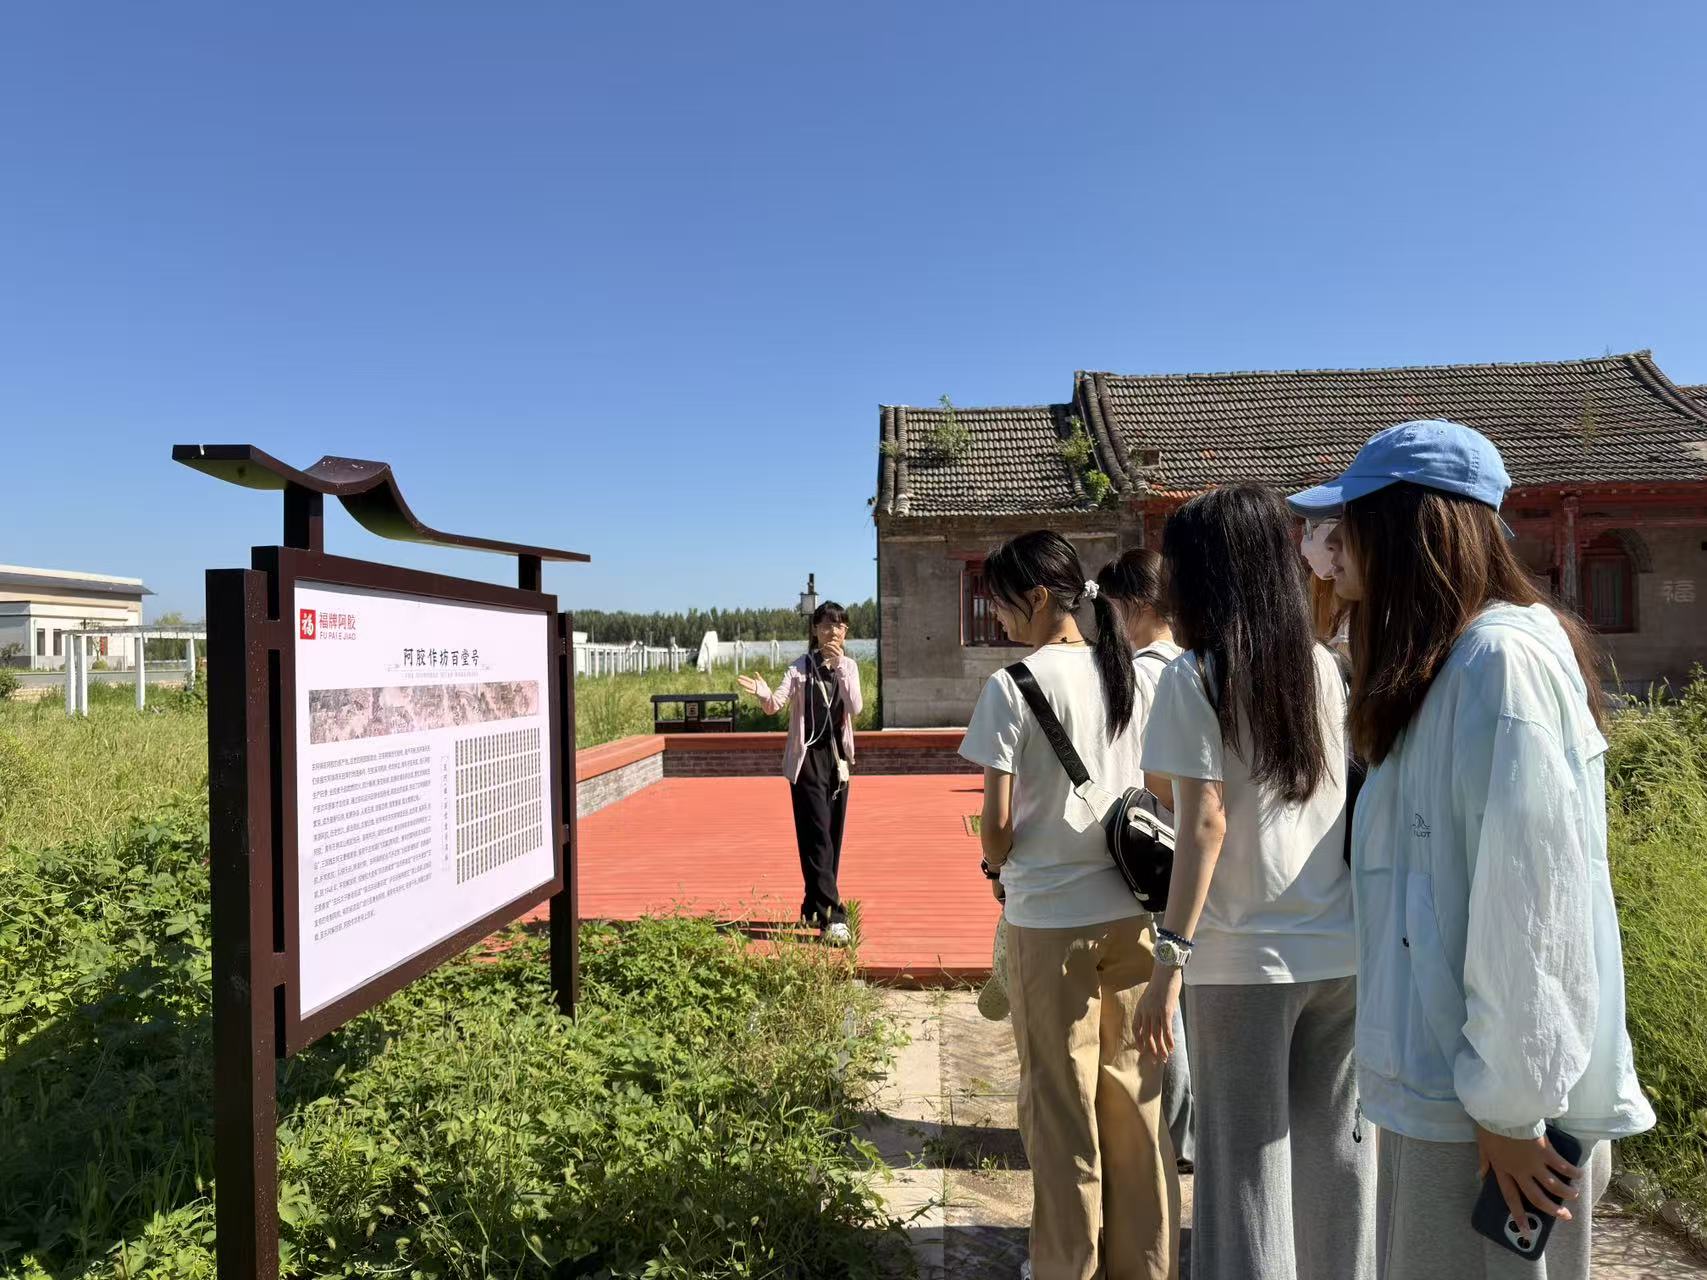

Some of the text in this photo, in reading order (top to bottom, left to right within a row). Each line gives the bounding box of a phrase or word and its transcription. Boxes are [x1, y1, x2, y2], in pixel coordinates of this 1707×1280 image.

[319, 611, 356, 631] 福牌阿胶
[403, 648, 480, 667] 阿胶作坊百堂号
